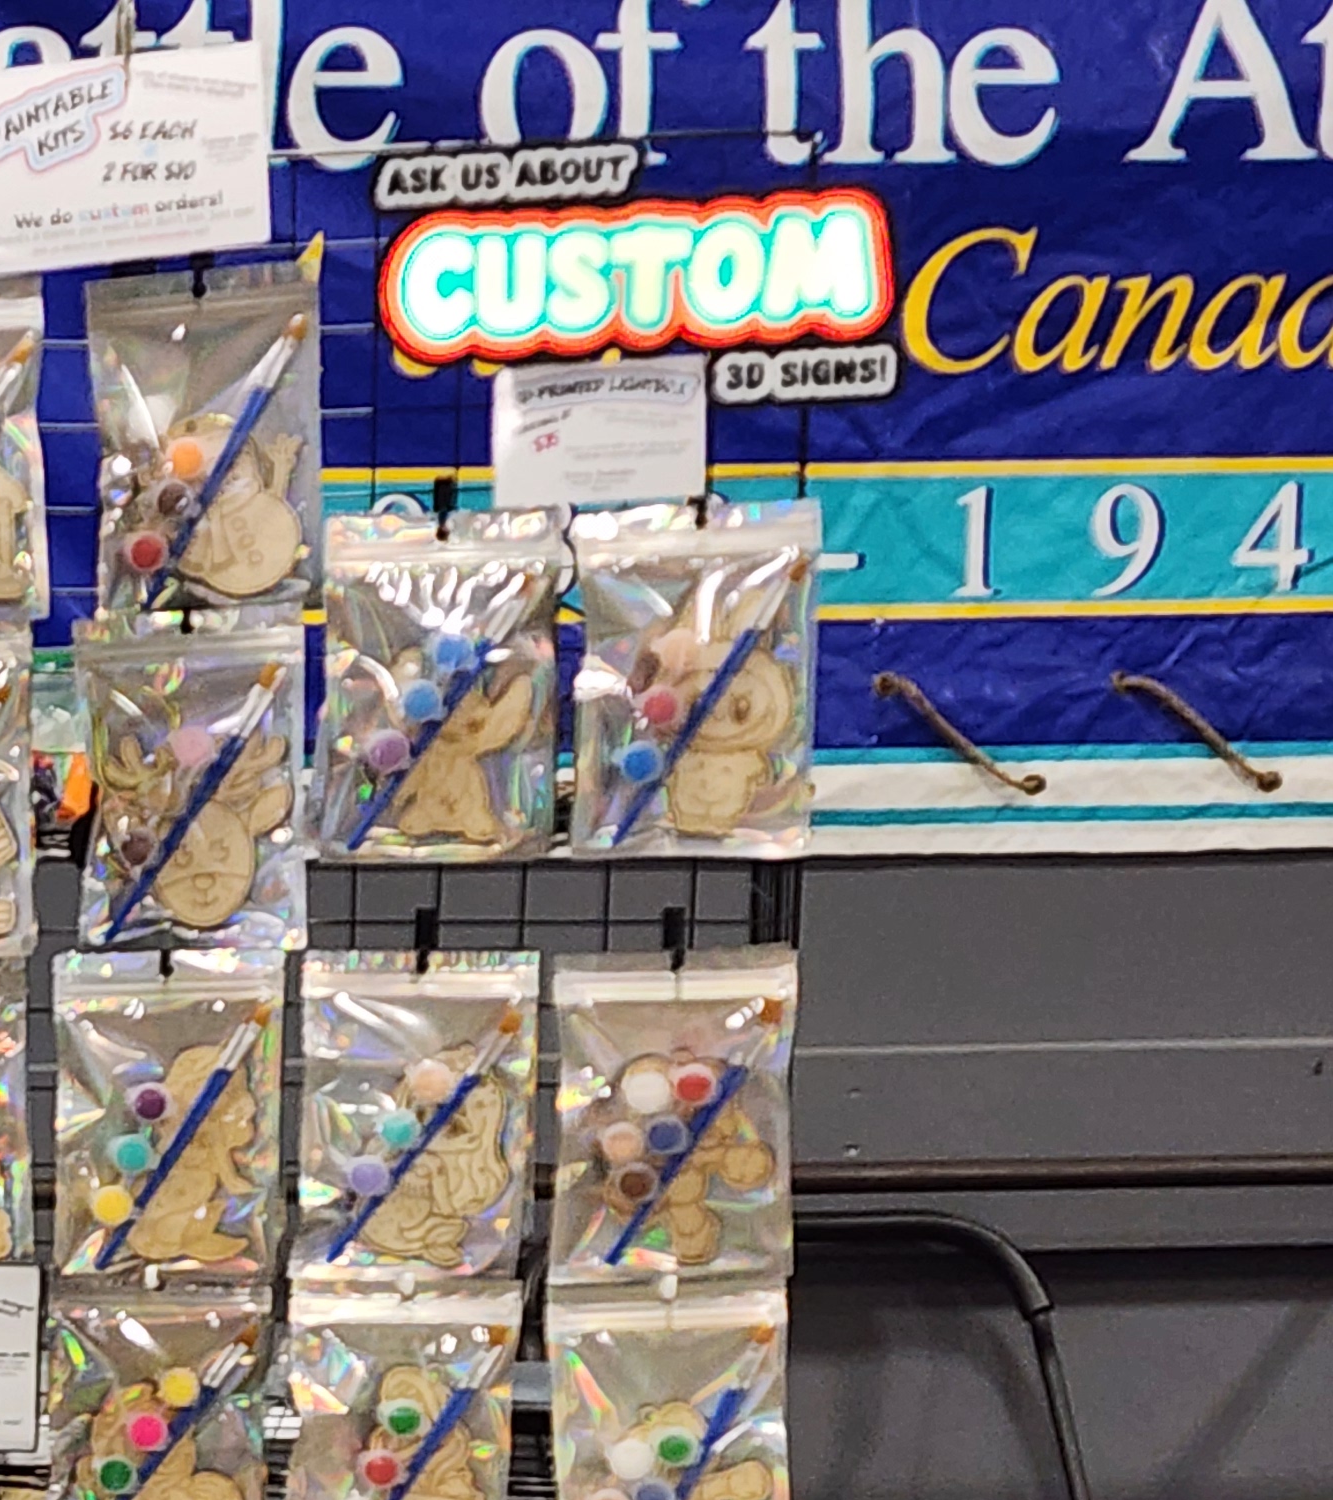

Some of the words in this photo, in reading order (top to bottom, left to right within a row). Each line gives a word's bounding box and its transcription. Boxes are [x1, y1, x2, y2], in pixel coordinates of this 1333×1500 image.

[479, 0, 682, 167] of
[744, 0, 1061, 167] the
[37, 120, 86, 156] KITS
[139, 119, 198, 141] EACH
[101, 162, 116, 182] 2
[120, 162, 157, 181] FOR
[386, 162, 448, 197] ASK
[461, 160, 501, 190] US
[515, 154, 629, 188] ABOUT
[14, 212, 44, 230] We
[50, 208, 73, 225] do
[154, 190, 224, 214] orders!
[401, 206, 874, 342] CUSTOM
[725, 361, 766, 390] 3D
[779, 355, 891, 388] SIGNS!
